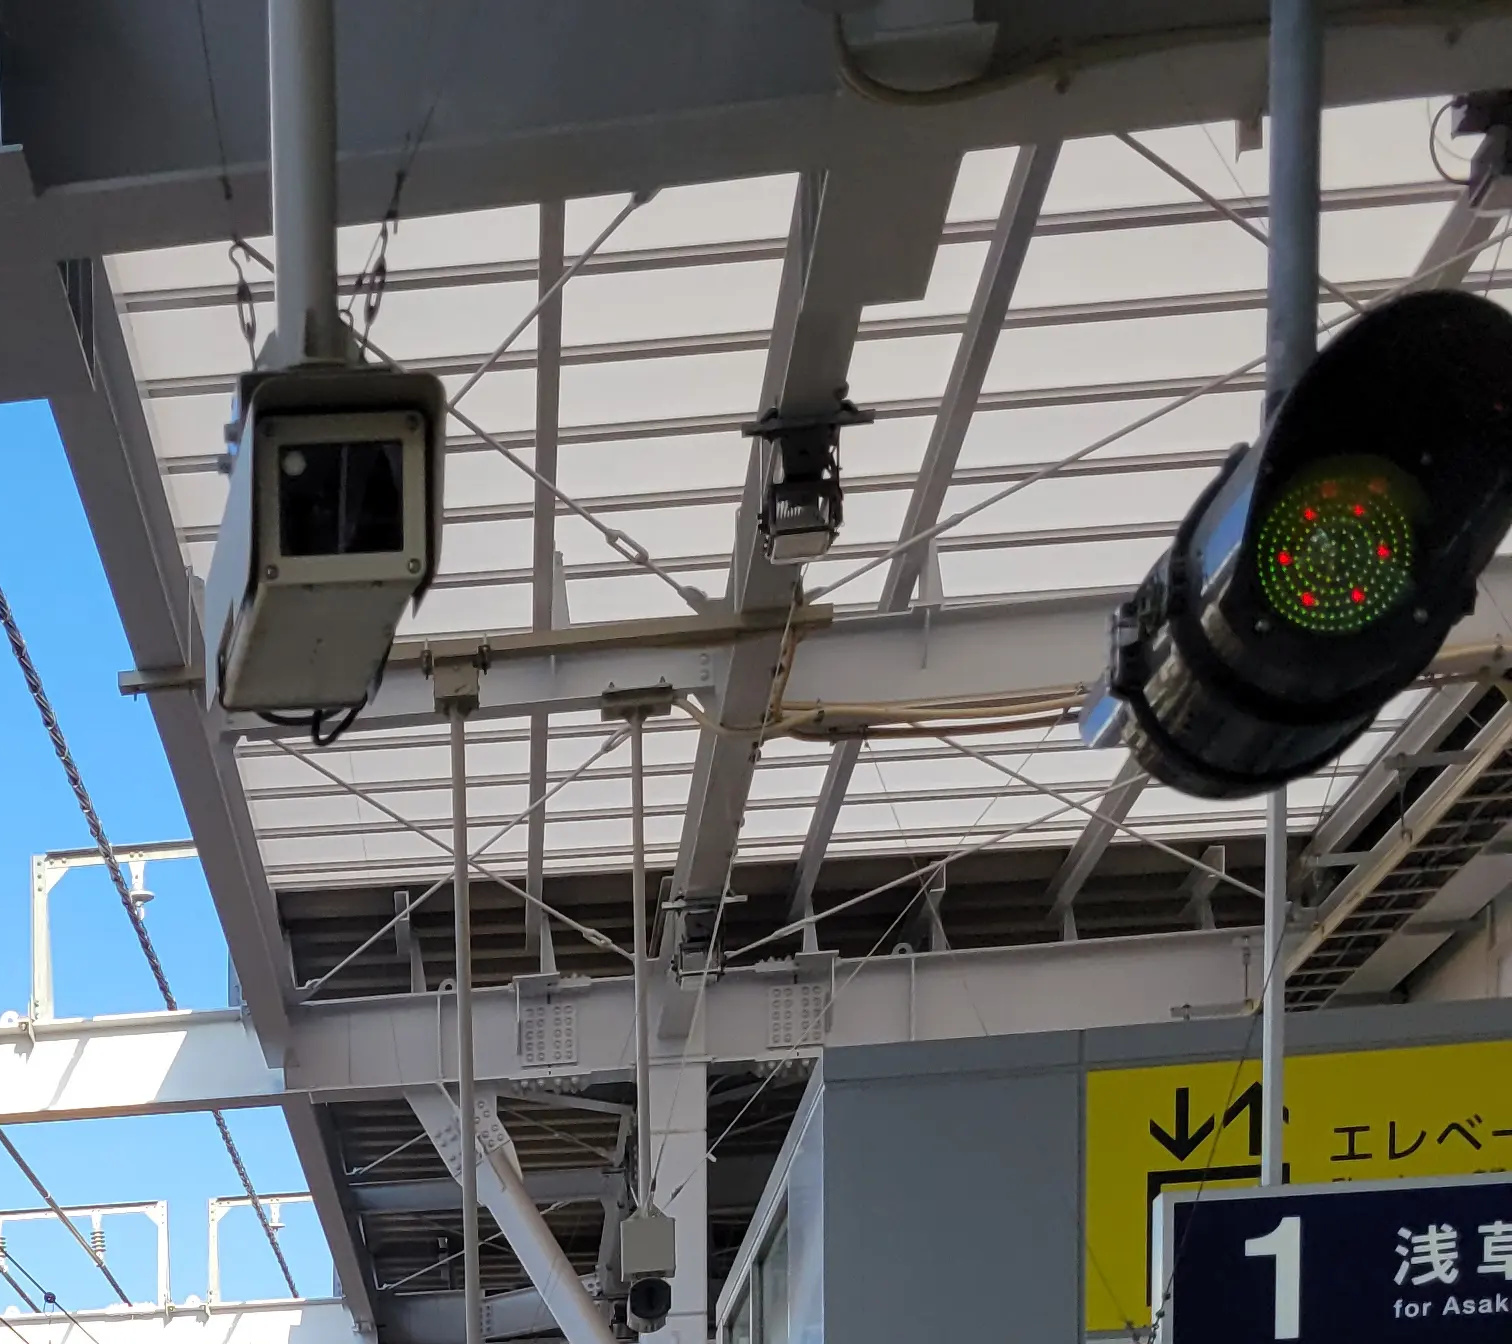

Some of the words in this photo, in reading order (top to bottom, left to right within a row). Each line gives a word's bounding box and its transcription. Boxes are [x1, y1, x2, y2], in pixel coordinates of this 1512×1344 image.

[1245, 1216, 1300, 1339] 1
[1393, 1299, 1431, 1318] for
[1442, 1292, 1512, 1315] Asak
